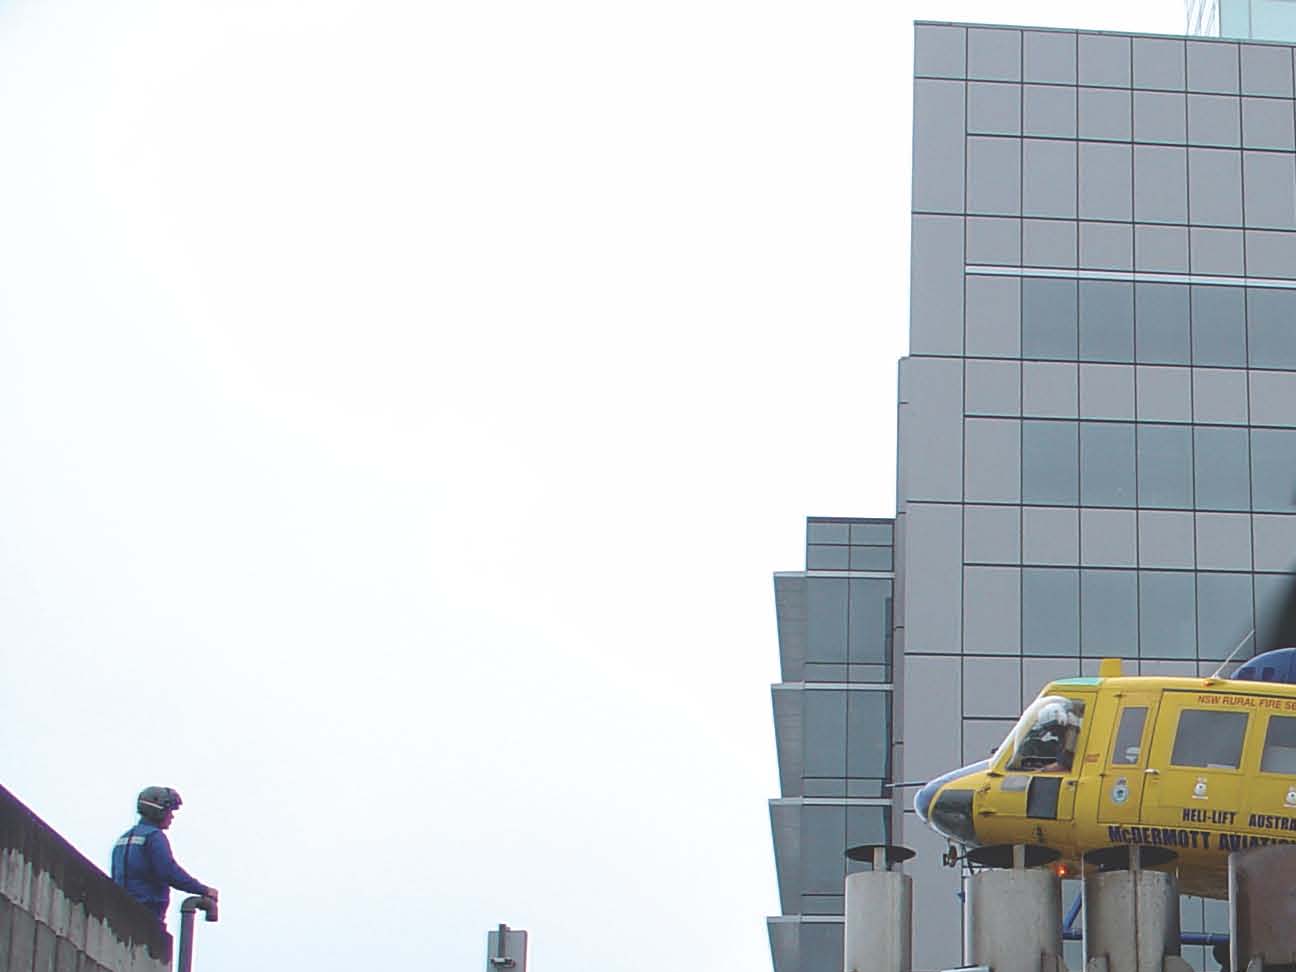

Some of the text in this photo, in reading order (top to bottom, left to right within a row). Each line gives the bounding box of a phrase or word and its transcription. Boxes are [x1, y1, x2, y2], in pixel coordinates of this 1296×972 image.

[1198, 695, 1219, 706] NSW
[1223, 696, 1256, 707] RURAL
[1258, 698, 1281, 709] FIRE
[1182, 808, 1237, 825] HELI-LIFT
[1108, 825, 1211, 849] McDERMOTT
